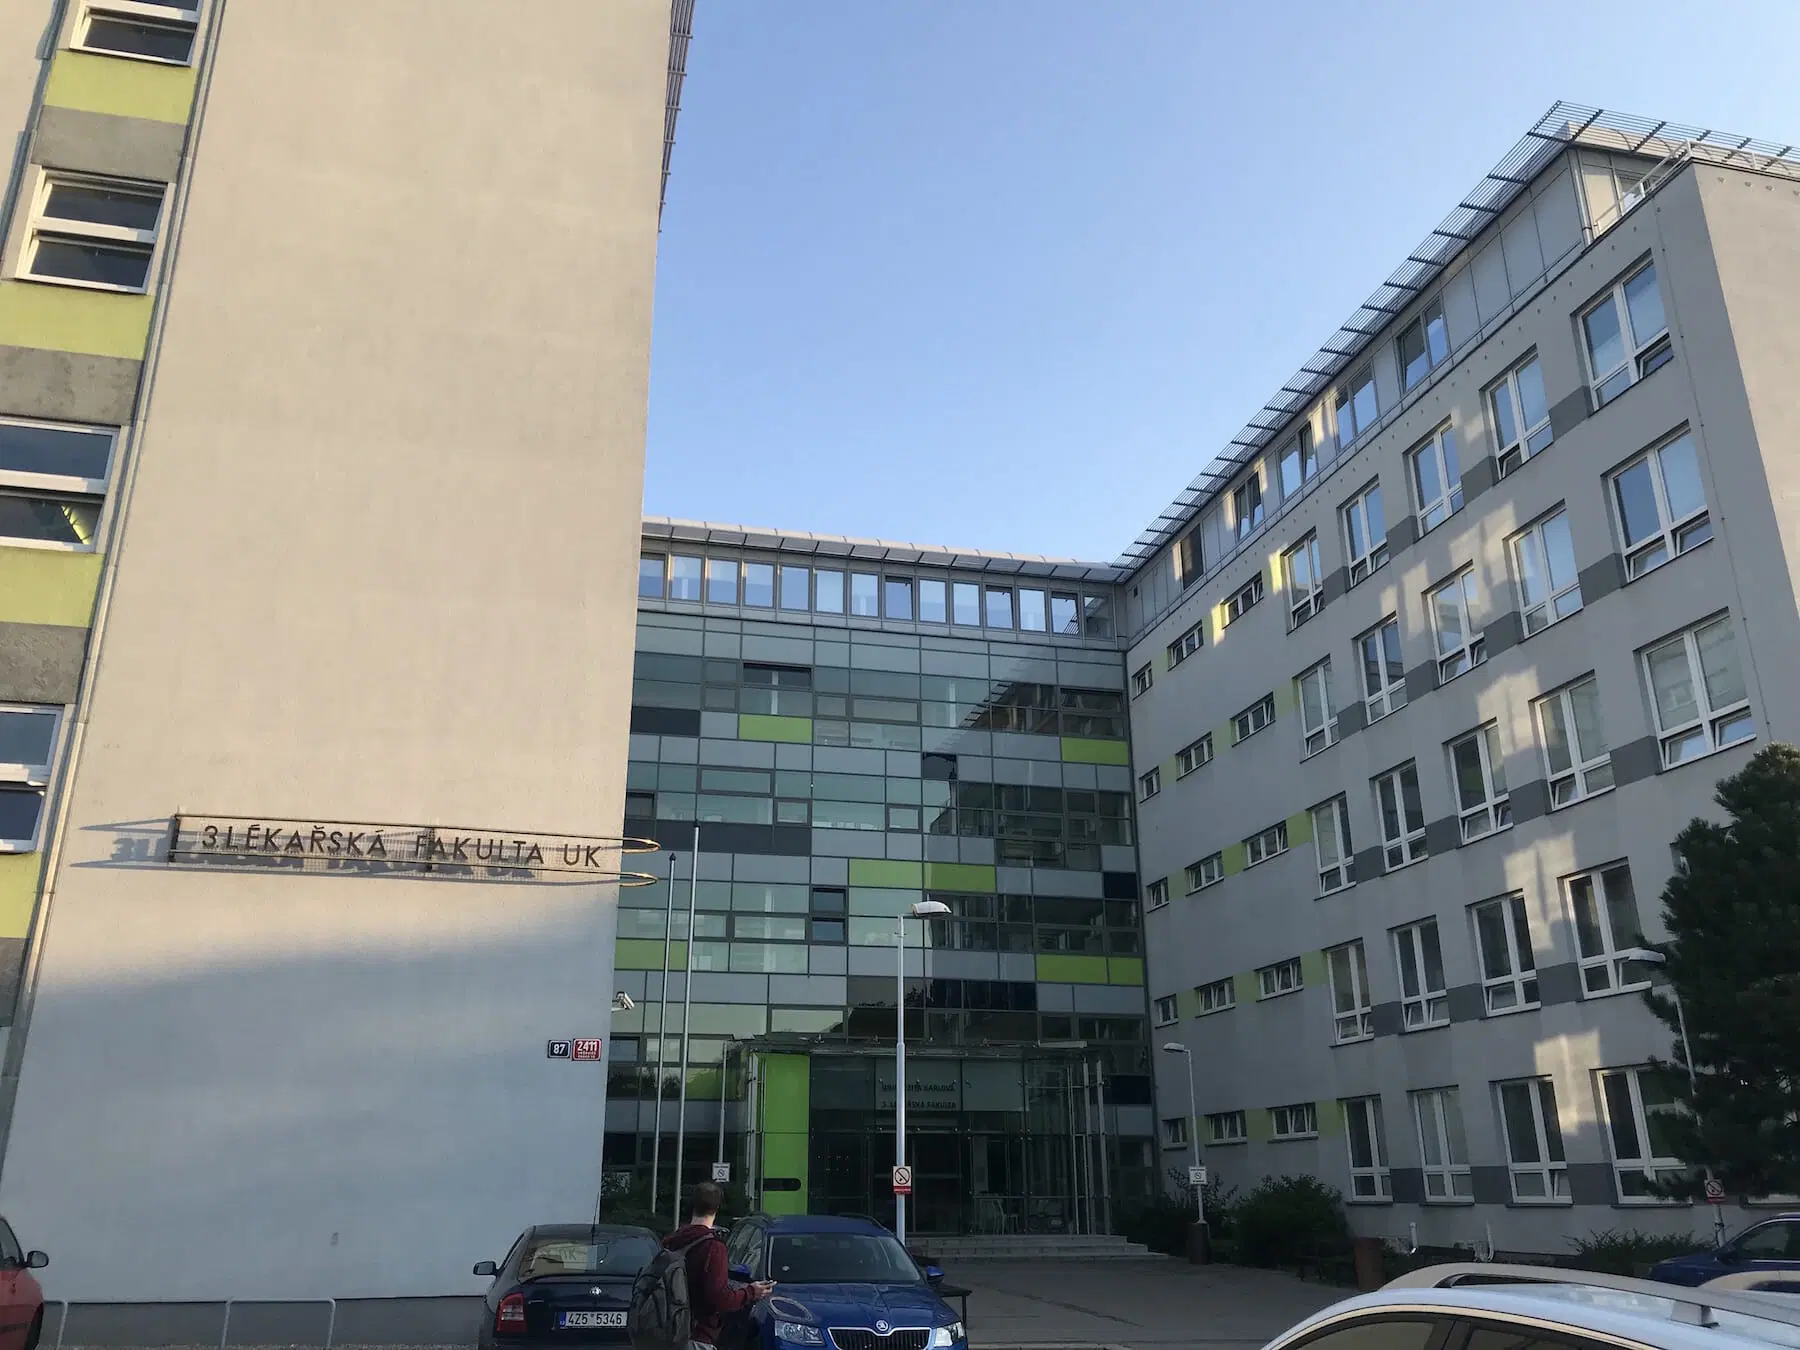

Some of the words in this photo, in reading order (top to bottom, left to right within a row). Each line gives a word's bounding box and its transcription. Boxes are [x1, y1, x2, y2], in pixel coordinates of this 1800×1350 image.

[414, 834, 544, 864] FAKULTA
[563, 843, 602, 867] UK
[553, 1044, 566, 1055] 87
[577, 1041, 597, 1051] 2411
[568, 1313, 588, 1325] 4Z5
[596, 1313, 622, 1325] 5346
